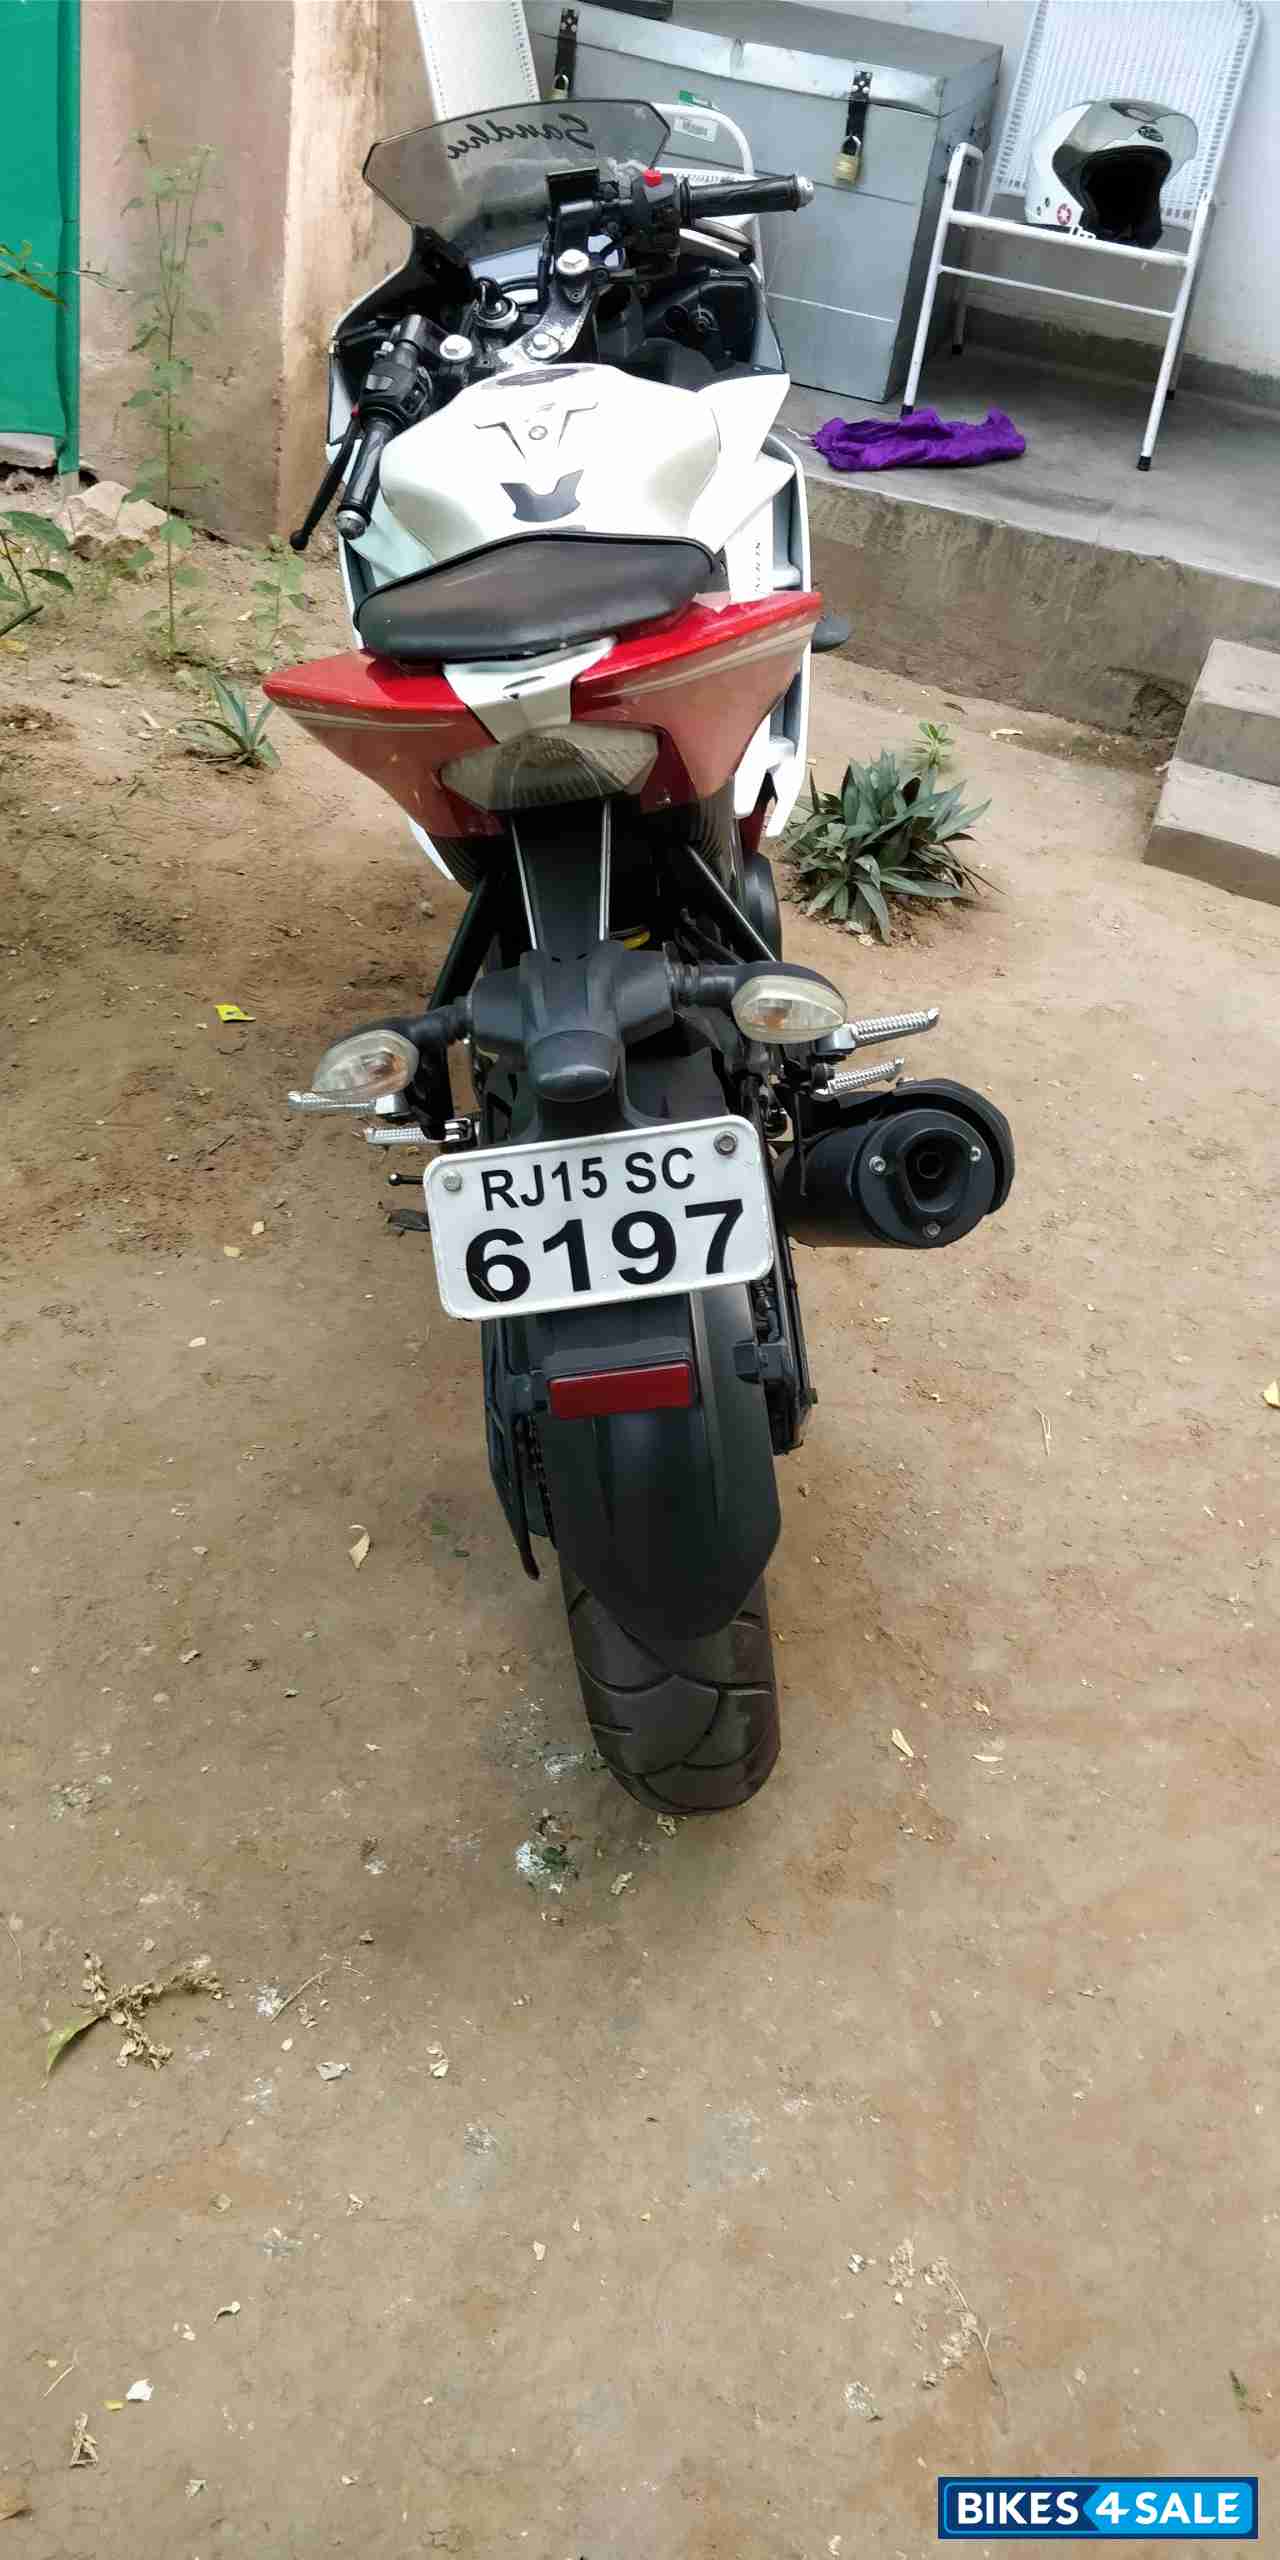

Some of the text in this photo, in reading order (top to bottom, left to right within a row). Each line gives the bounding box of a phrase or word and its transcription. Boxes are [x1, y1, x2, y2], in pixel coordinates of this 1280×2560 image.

[481, 1147, 696, 1211] RJ15 SC
[465, 1199, 744, 1303] 6197
